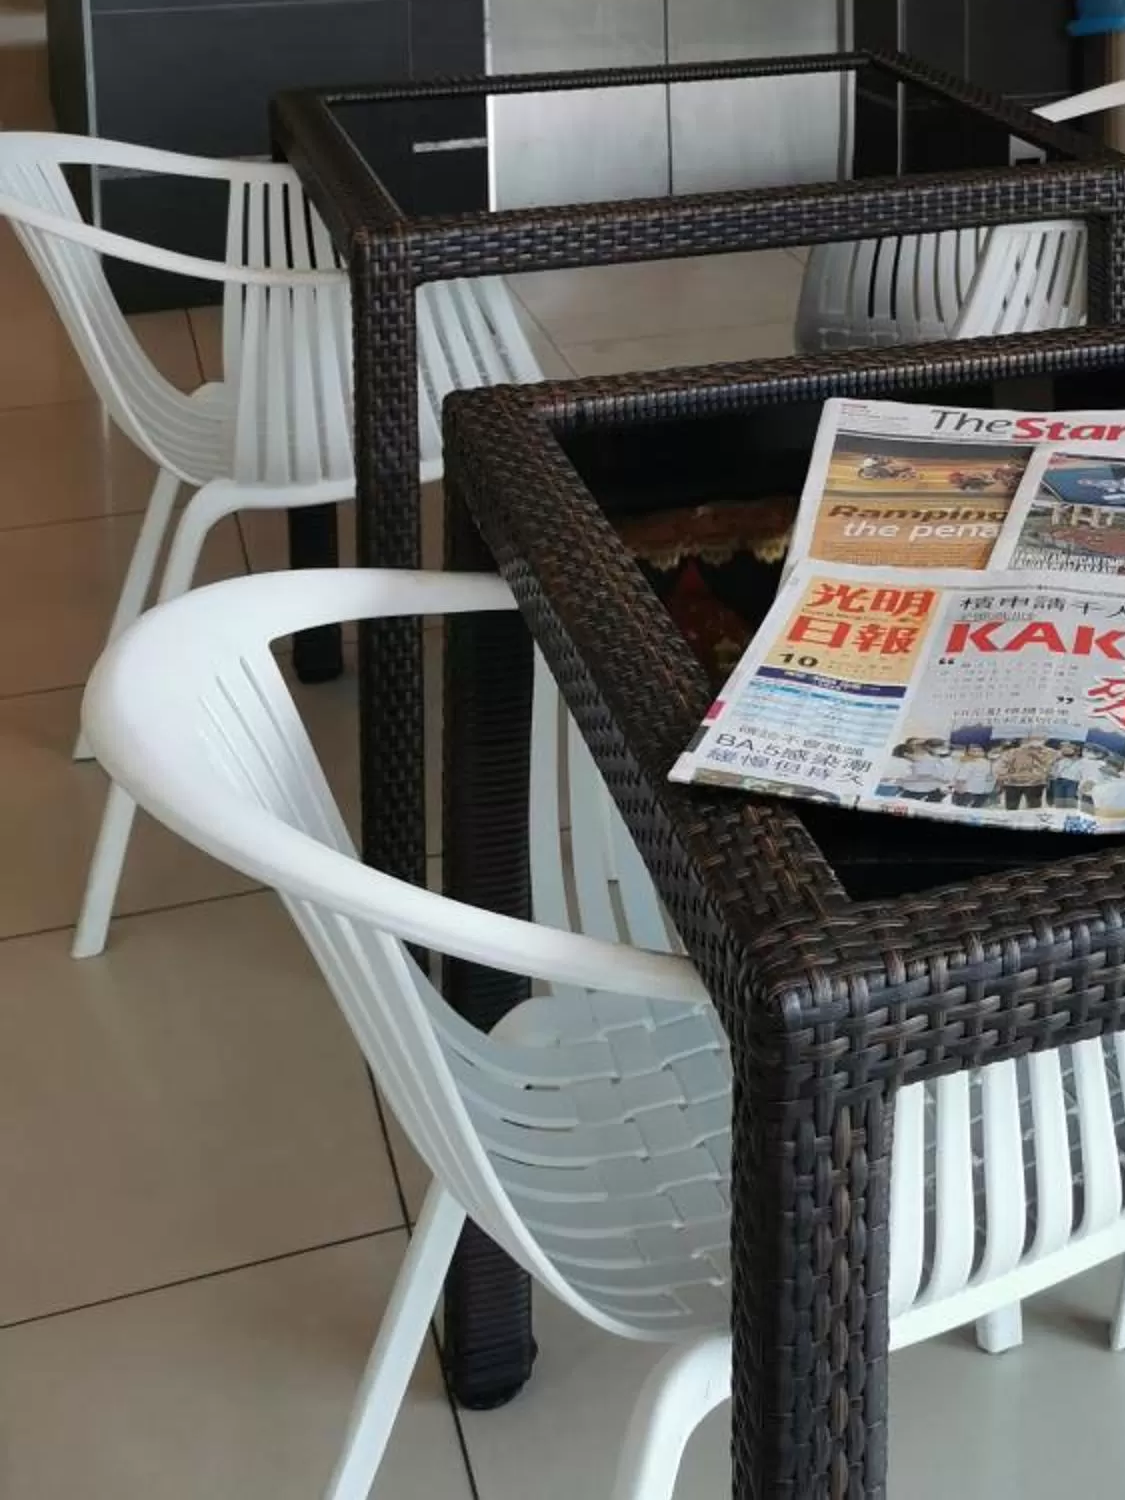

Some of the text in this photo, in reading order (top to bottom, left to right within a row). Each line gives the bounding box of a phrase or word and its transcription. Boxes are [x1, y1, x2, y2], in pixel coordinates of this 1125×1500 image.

[828, 504, 1008, 524] Ramping
[843, 519, 899, 538] the
[804, 583, 937, 618] 光明
[786, 615, 919, 656] 日報
[778, 652, 818, 668] 10
